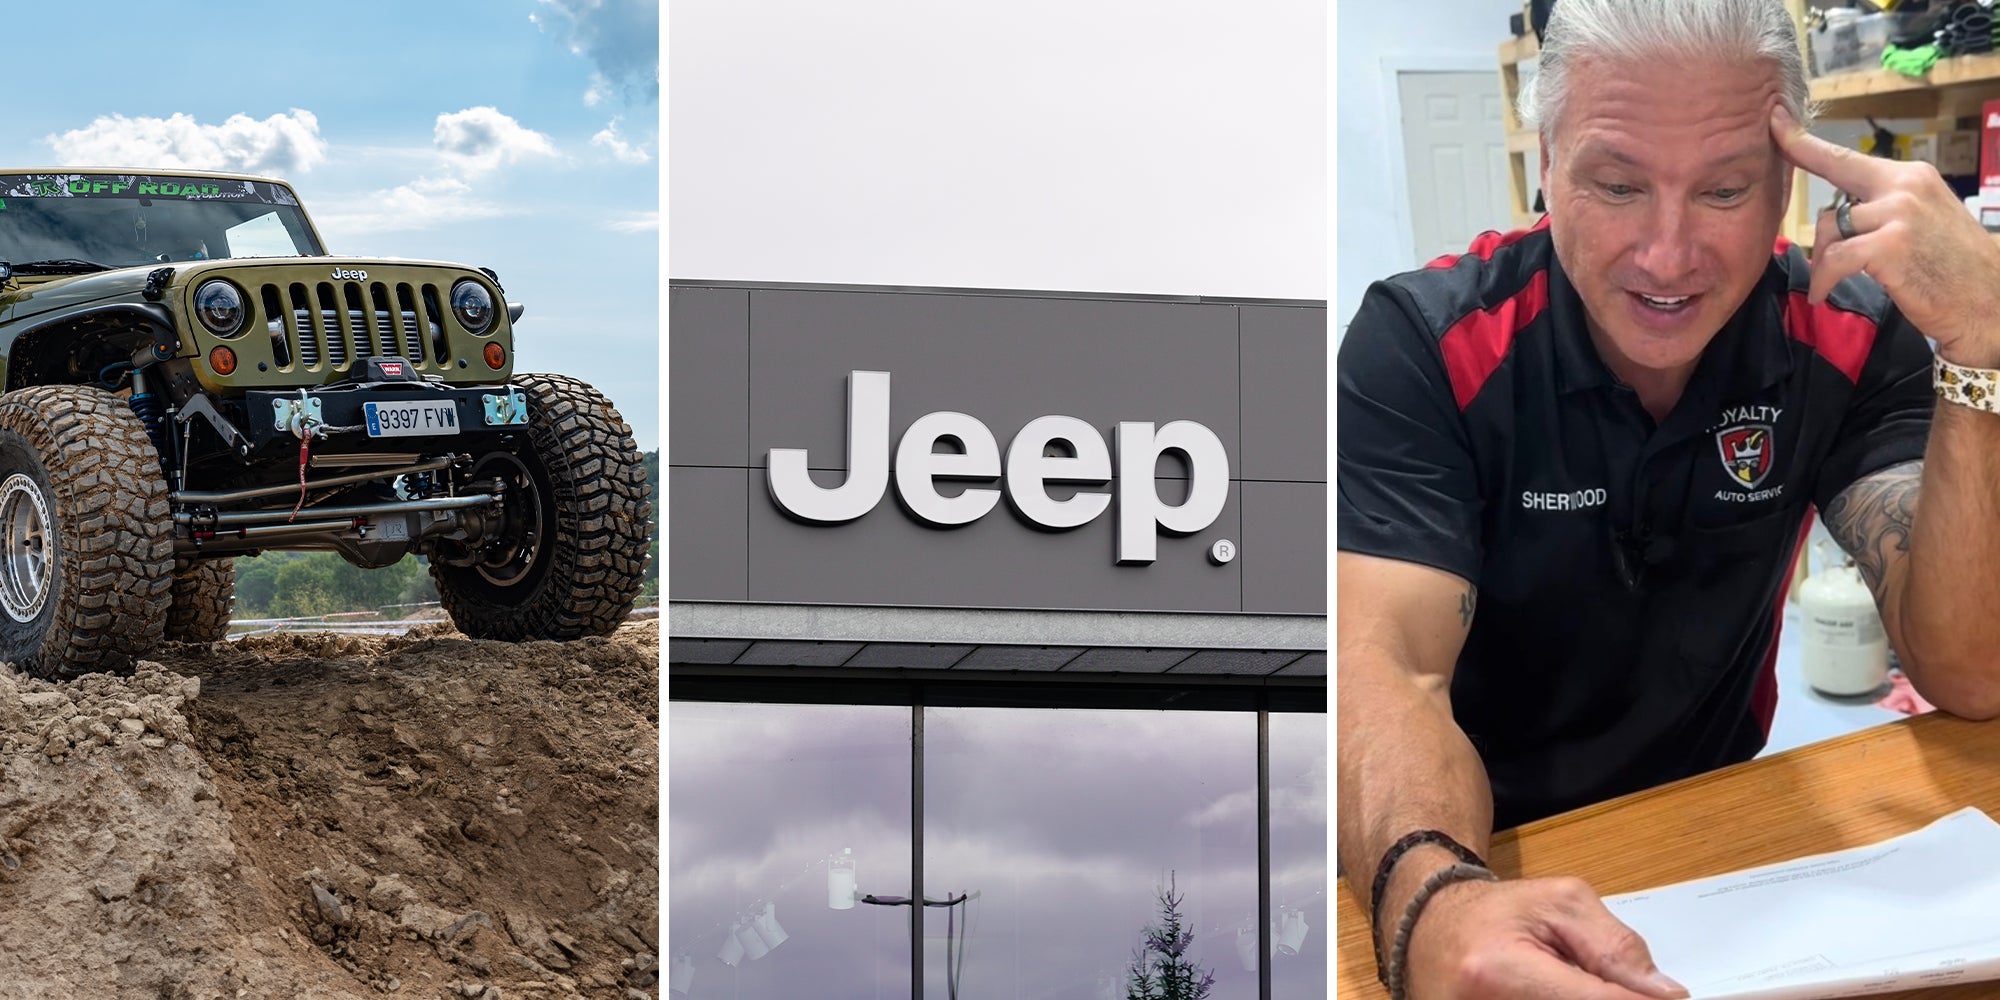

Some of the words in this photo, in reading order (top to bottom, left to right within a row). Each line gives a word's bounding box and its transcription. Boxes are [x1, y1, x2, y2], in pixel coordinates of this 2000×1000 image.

[69, 180, 129, 194] OFF
[139, 182, 219, 196] ROAD
[331, 267, 368, 281] Jeep
[380, 409, 419, 430] 9397
[424, 408, 454, 428] FVW
[767, 370, 1230, 565] Jeep
[1714, 490, 1746, 503] AUTO
[1747, 485, 1785, 502] SERVIC
